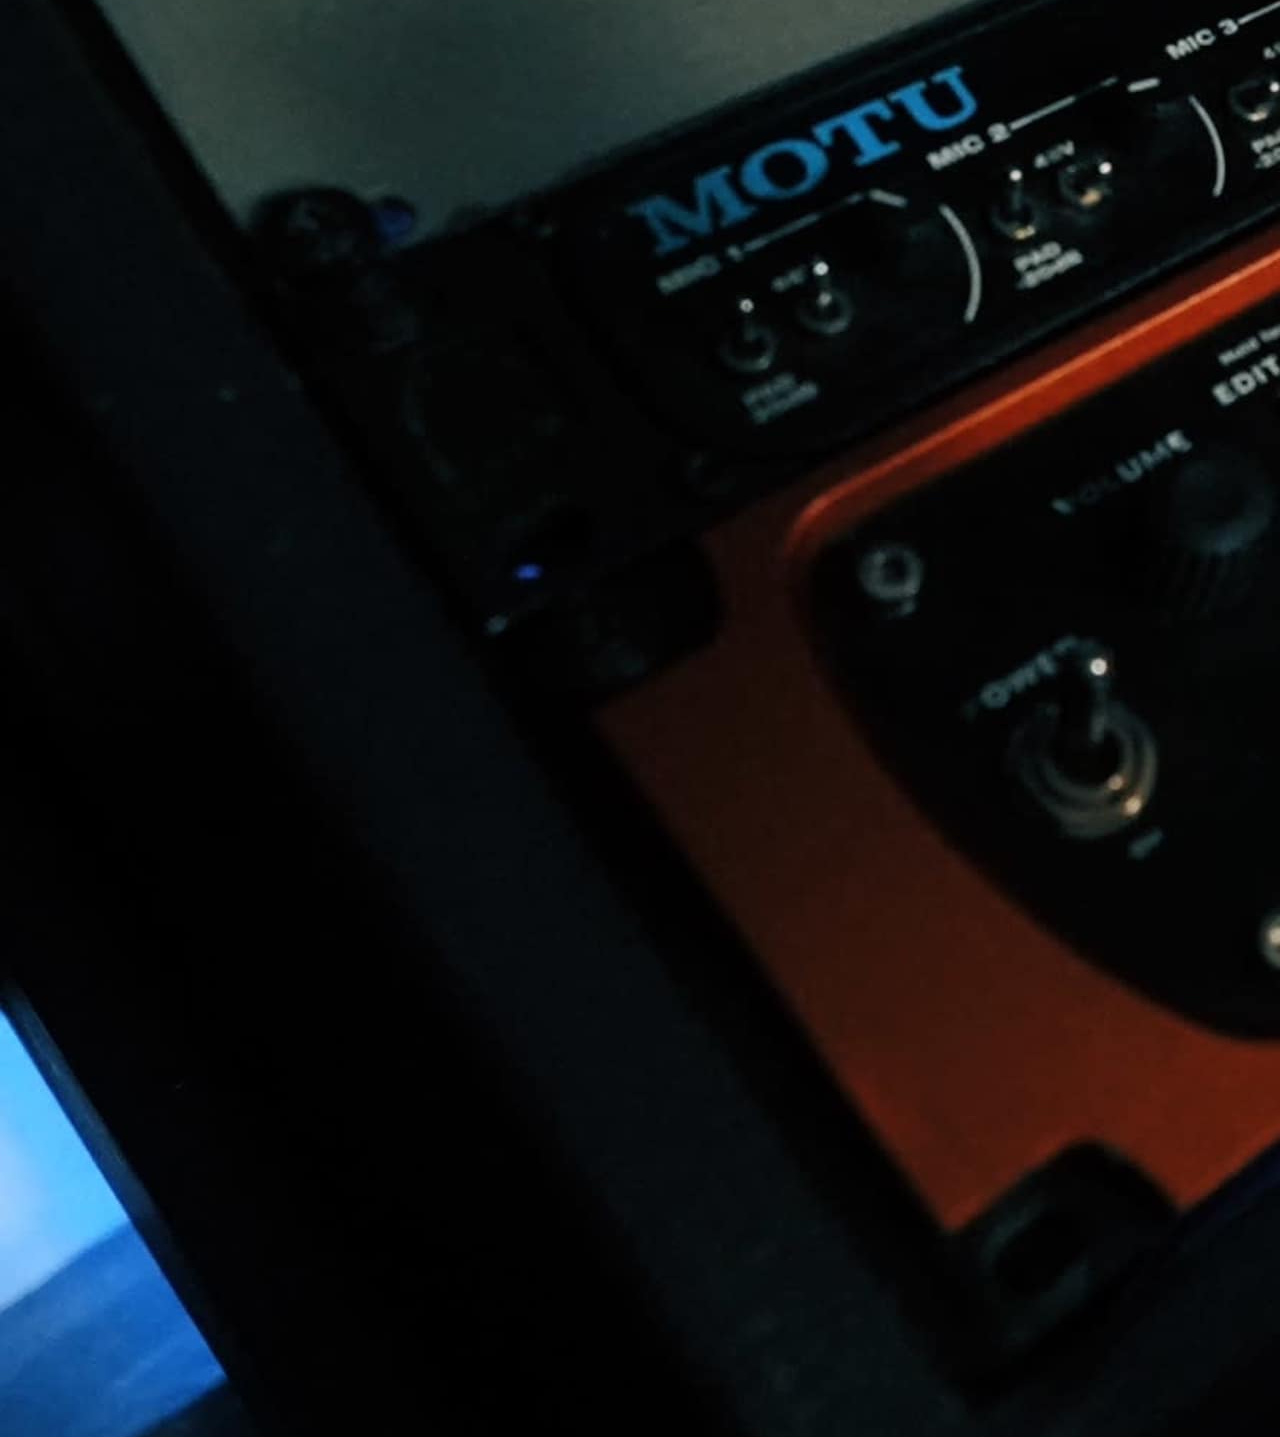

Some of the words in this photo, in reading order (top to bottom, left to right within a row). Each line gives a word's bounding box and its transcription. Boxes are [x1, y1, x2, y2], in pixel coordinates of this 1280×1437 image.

[1165, 28, 1216, 61] MIC
[1217, 18, 1240, 37] 3
[626, 64, 978, 256] MOTU
[925, 132, 986, 171] MIC
